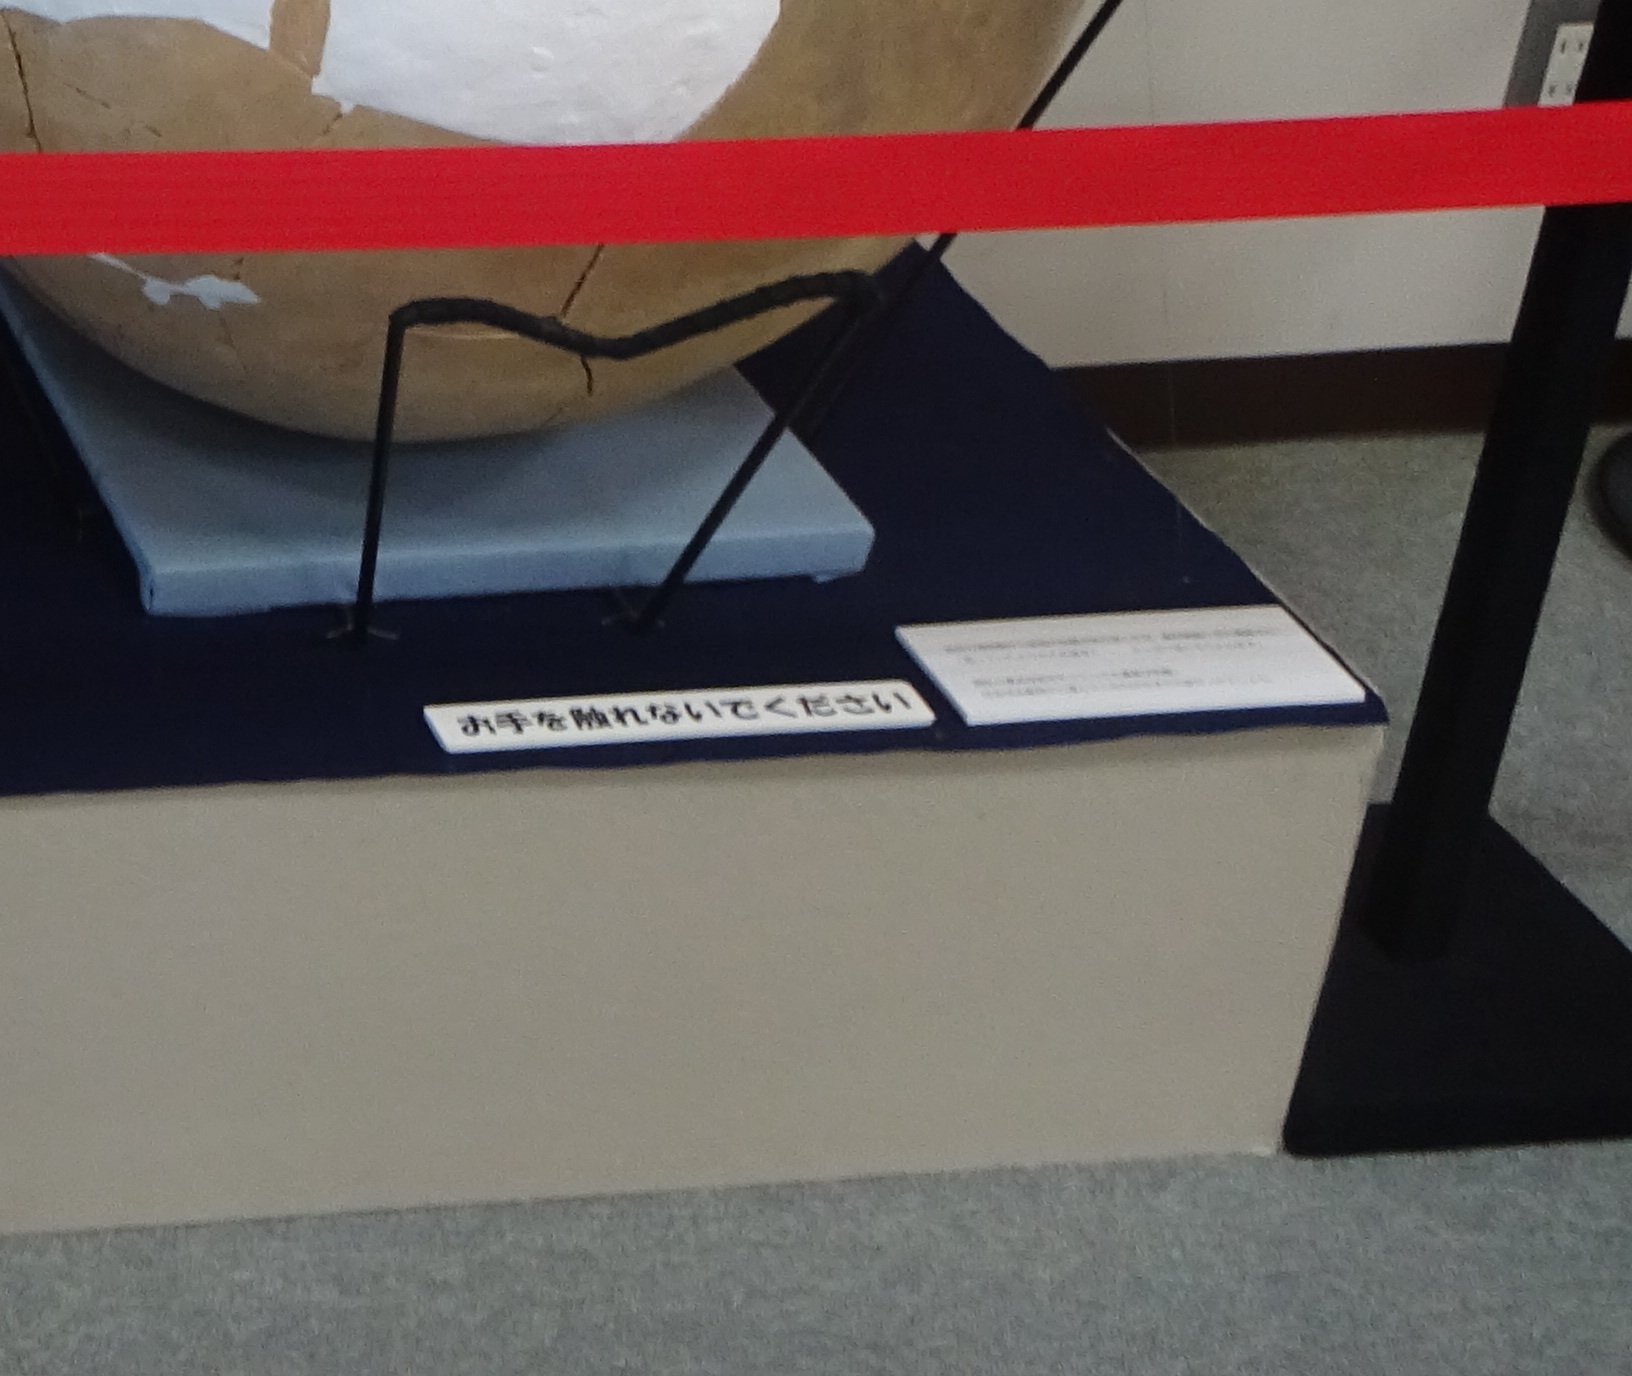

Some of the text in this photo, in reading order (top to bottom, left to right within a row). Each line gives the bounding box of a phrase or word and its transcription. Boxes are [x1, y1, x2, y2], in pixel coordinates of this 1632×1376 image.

[460, 691, 913, 737] お手を触れないでください
